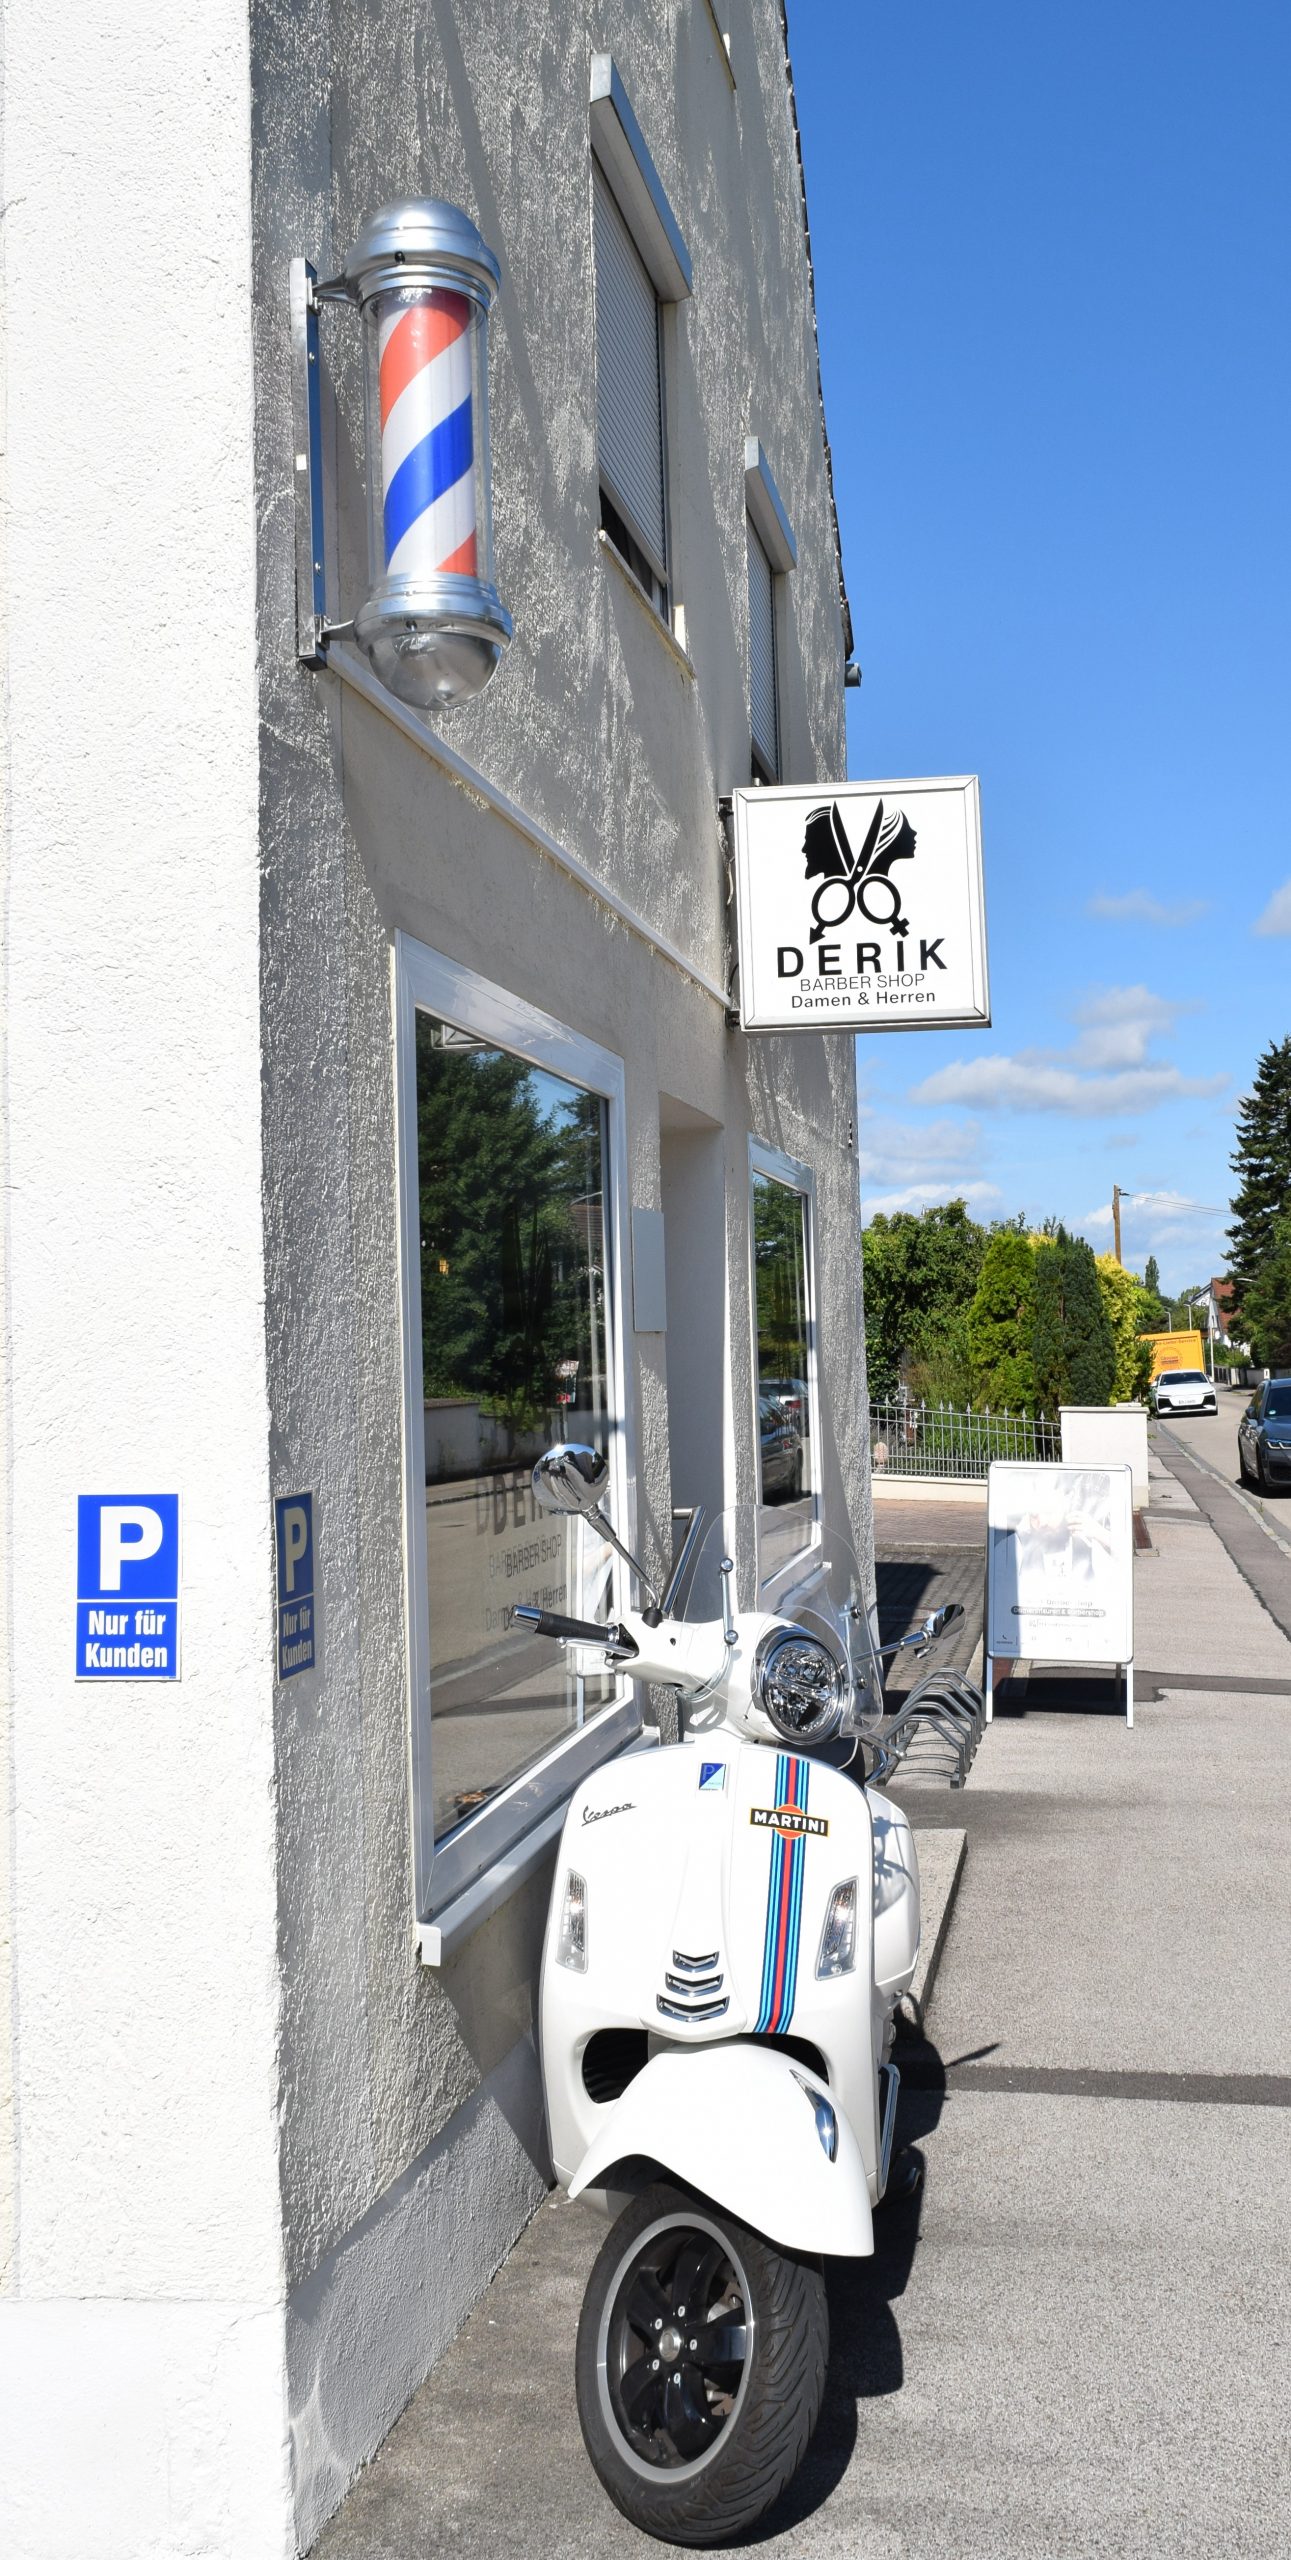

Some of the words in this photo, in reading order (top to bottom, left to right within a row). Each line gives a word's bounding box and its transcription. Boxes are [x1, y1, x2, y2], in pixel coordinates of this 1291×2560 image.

[777, 938, 948, 978] DERIK
[800, 976, 872, 992] BARBER
[877, 973, 925, 988] SHOP
[791, 993, 851, 1009] Damen
[858, 992, 870, 1005] &
[877, 991, 936, 1005] Herren
[100, 1505, 163, 1591] P
[284, 1506, 308, 1593] P
[541, 1534, 562, 1563] SHOP
[88, 1610, 128, 1635] Nur
[134, 1609, 166, 1635] für
[283, 1612, 298, 1638] Nur
[300, 1606, 311, 1631] für
[85, 1643, 167, 1668] Kunden
[282, 1639, 312, 1670] Kunden
[581, 1802, 639, 1827] Vespa
[753, 1811, 826, 1834] MARTINI
